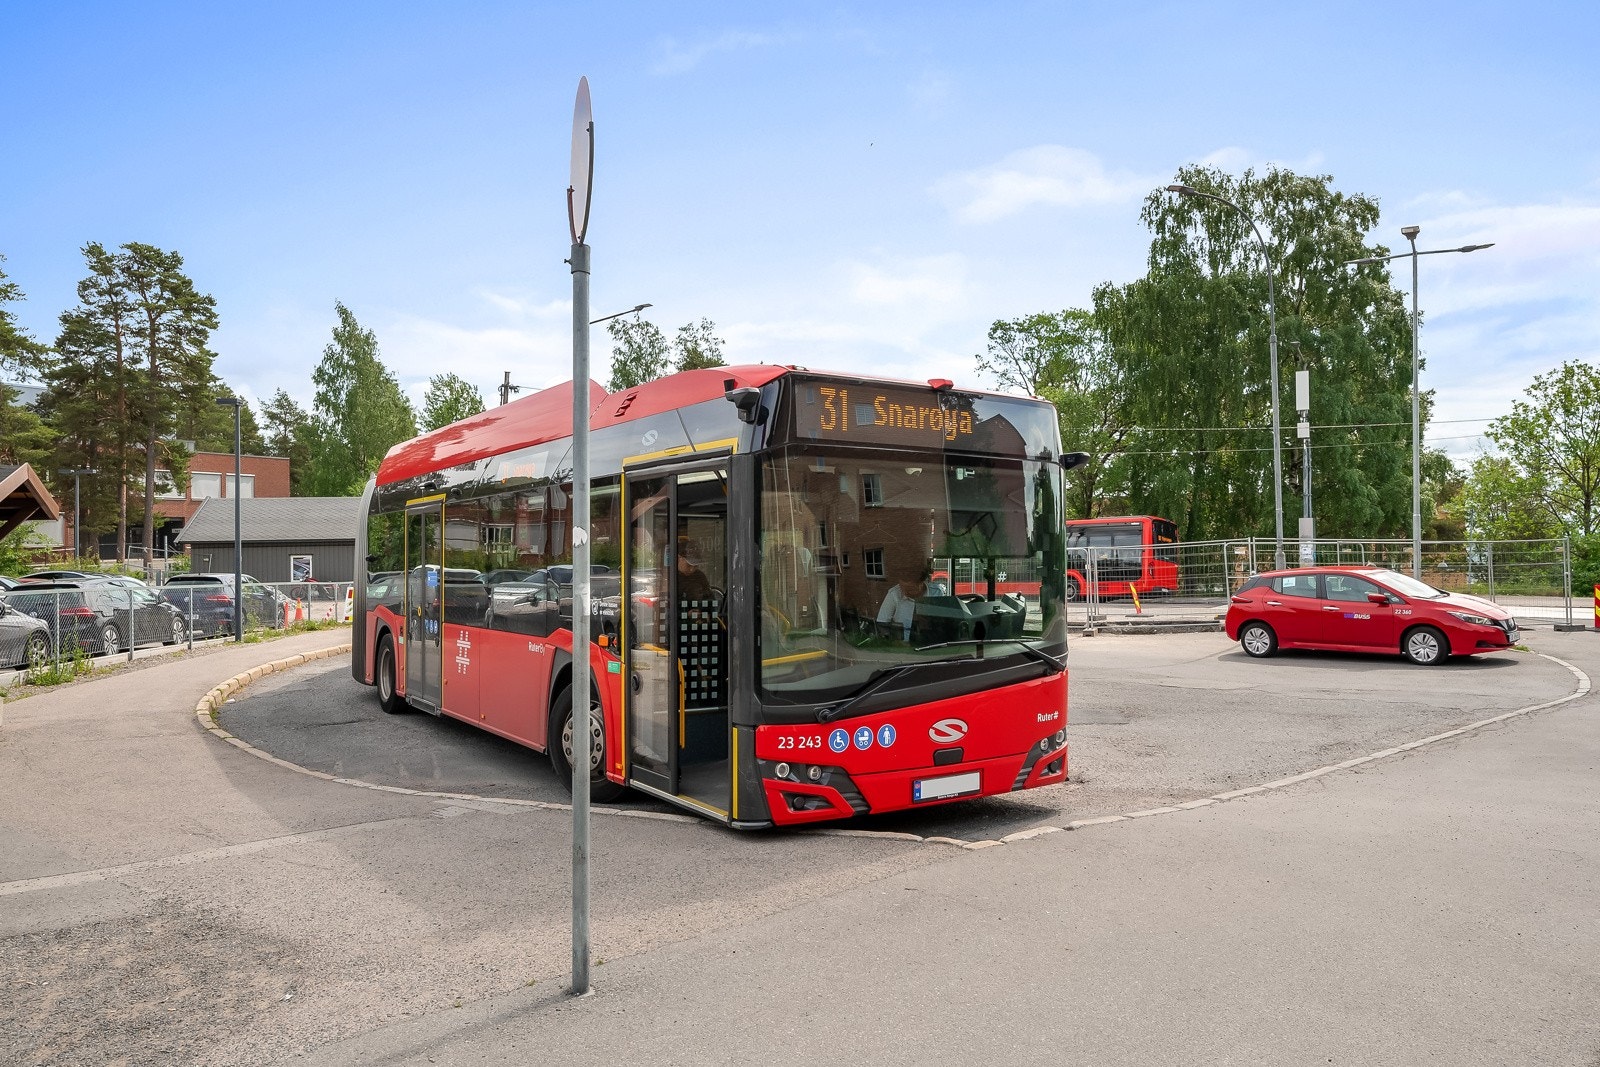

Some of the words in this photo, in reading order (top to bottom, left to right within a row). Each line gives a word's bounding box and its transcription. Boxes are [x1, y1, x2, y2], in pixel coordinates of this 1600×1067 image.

[820, 387, 847, 431] 31
[874, 396, 972, 441] Snarøya
[778, 736, 794, 749] 23
[798, 735, 822, 749] 243
